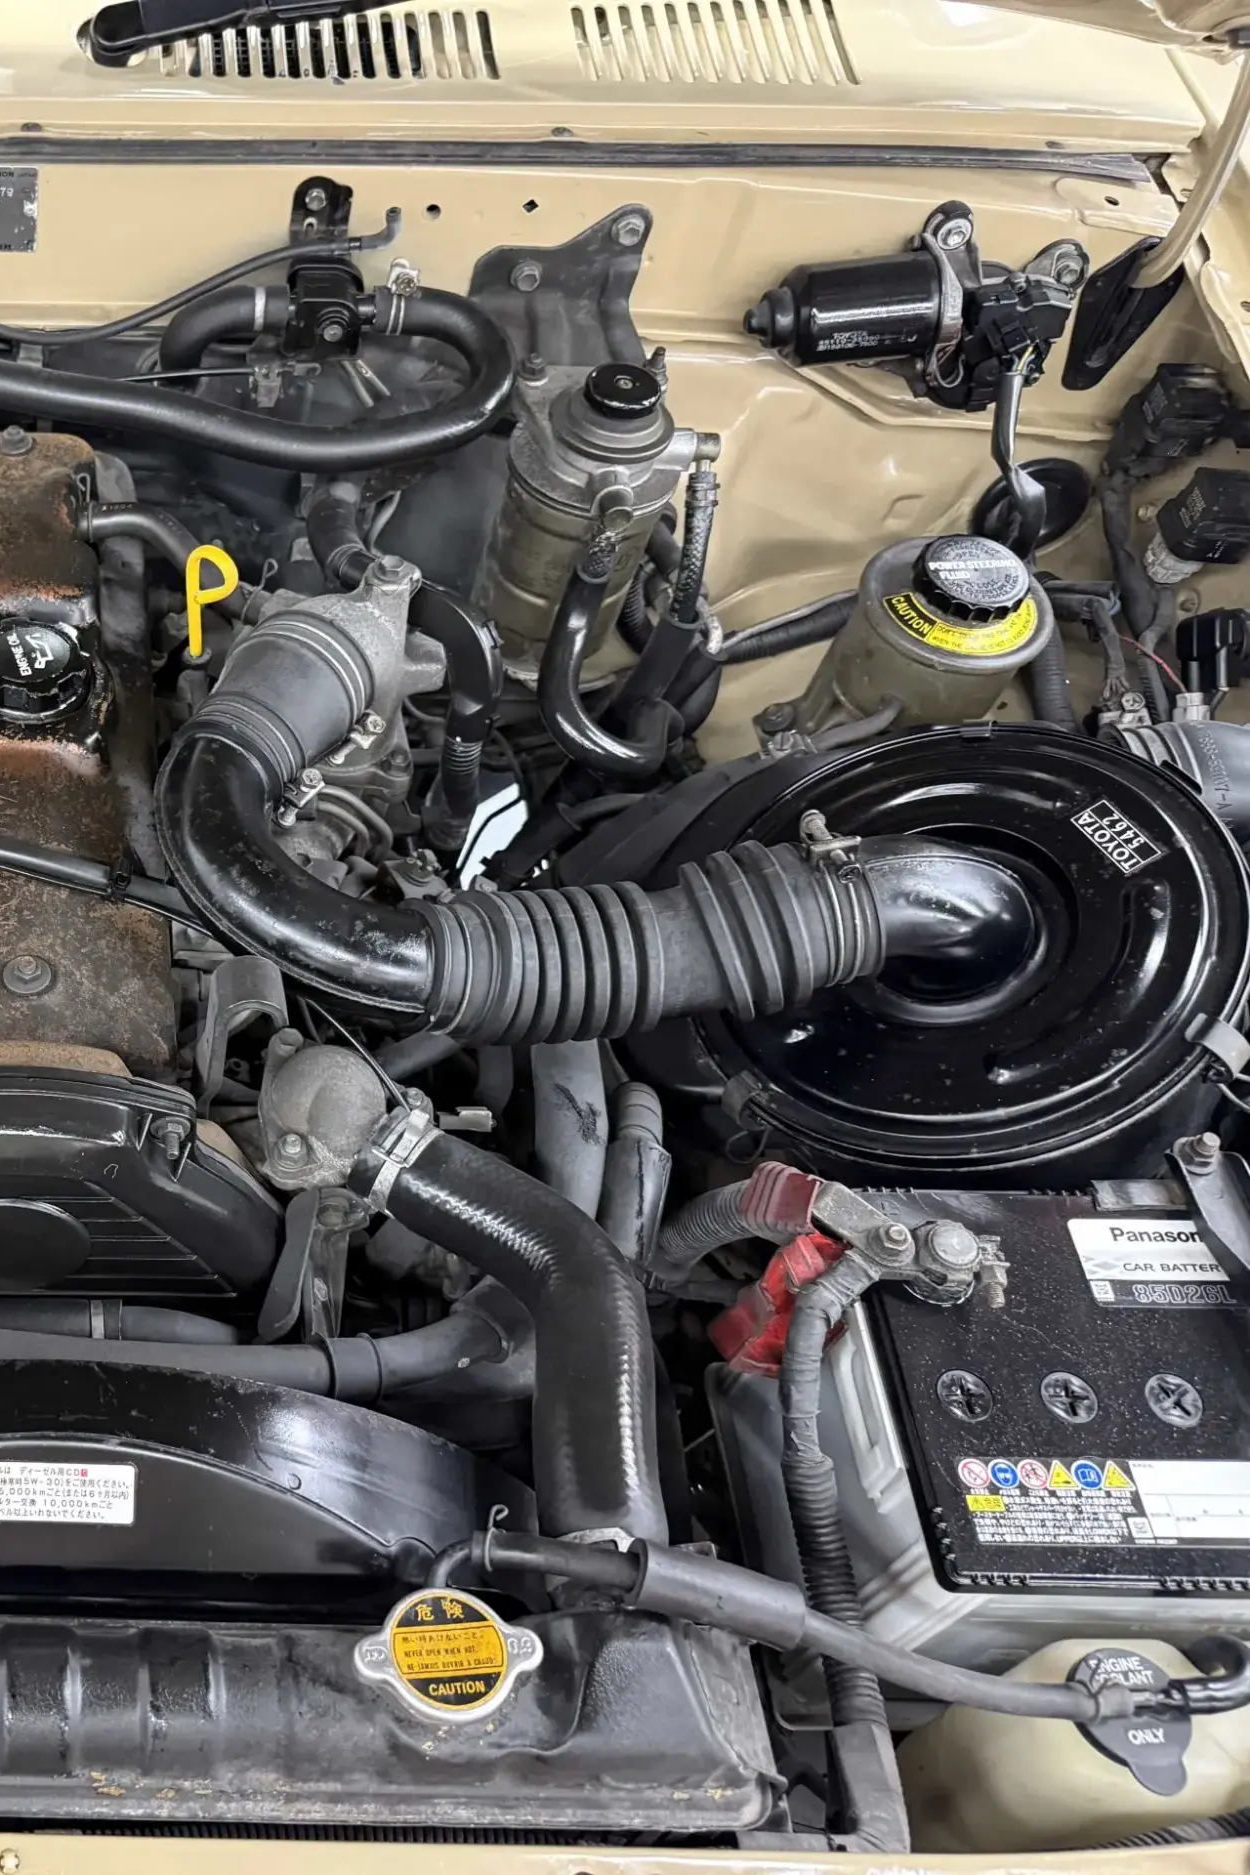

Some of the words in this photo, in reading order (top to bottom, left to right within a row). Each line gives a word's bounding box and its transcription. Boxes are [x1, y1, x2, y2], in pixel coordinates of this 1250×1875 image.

[928, 561, 965, 571] POWER
[966, 559, 1016, 569] STEERING
[939, 570, 970, 580] FLUID
[892, 596, 932, 634] CAUTION
[6, 632, 20, 646] OIL
[11, 645, 32, 676] ENGINE
[1102, 813, 1145, 849] 5462
[1078, 812, 1137, 870] TOYOTA
[1109, 1227, 1203, 1243] Panason
[1123, 1263, 1155, 1272] CAR
[1160, 1263, 1222, 1273] BATTER
[1132, 1284, 1238, 1304] 85D26L
[415, 1597, 465, 1622] 危険
[404, 1649, 424, 1658] NEVER
[425, 1648, 442, 1657] OPEN
[443, 1647, 461, 1656] WHEN
[1088, 1656, 1144, 1673] ENGINE
[428, 1680, 486, 1697] CAUTION
[1127, 1728, 1166, 1745] ONLY
